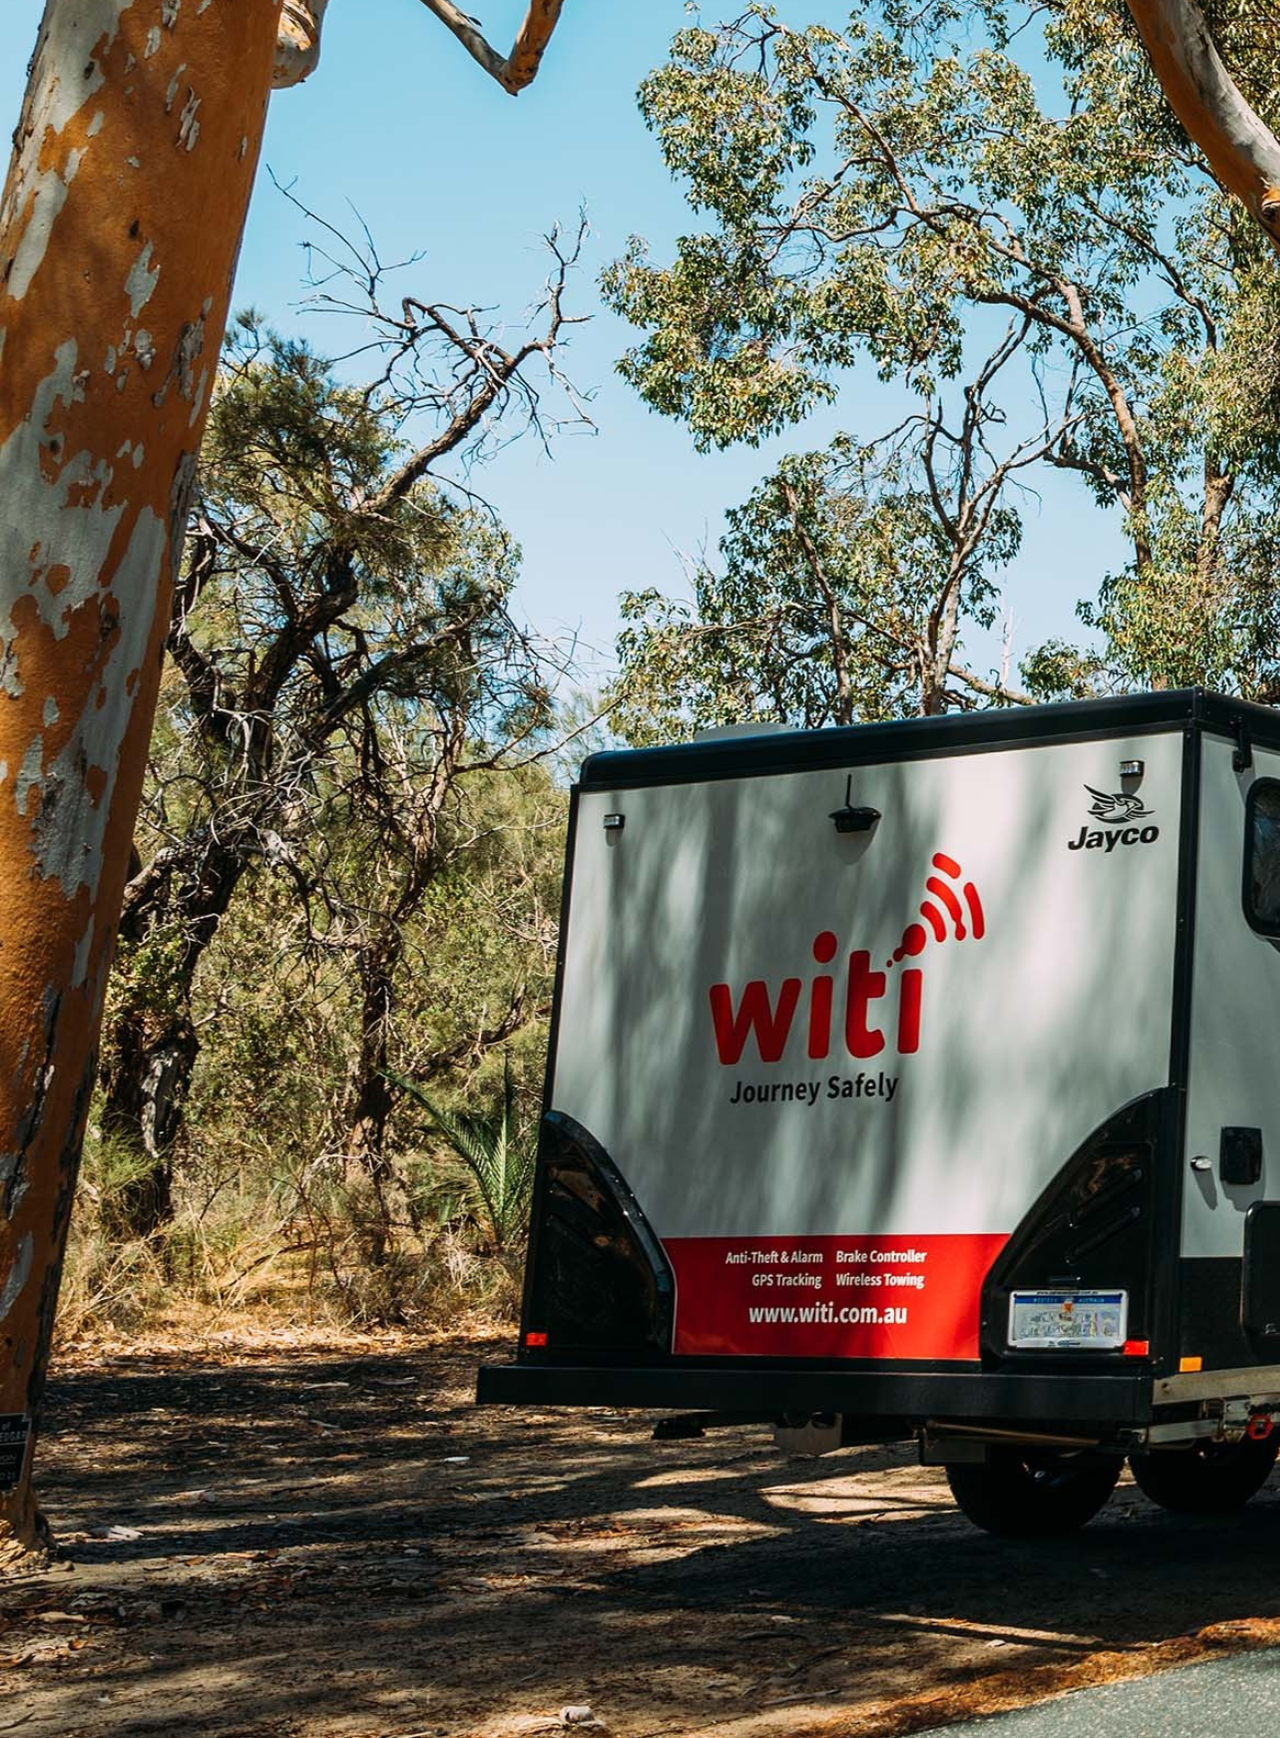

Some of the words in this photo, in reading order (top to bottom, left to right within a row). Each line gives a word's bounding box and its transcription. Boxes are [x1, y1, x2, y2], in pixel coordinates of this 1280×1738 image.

[1067, 826, 1160, 853] Jayco
[709, 923, 926, 1065] witi
[730, 1080, 821, 1106] Journey
[827, 1072, 899, 1102] Safely
[725, 1250, 779, 1264] Anti-Theft
[780, 1252, 790, 1264] &
[790, 1251, 823, 1263] Alarm
[836, 1250, 867, 1263] Brake
[869, 1249, 927, 1263] Controller
[752, 1274, 774, 1287] GPS
[776, 1273, 822, 1290] Tracking
[836, 1273, 882, 1287] Wireless
[884, 1273, 925, 1290] Towing
[749, 1301, 907, 1324] www.witi.com.au
